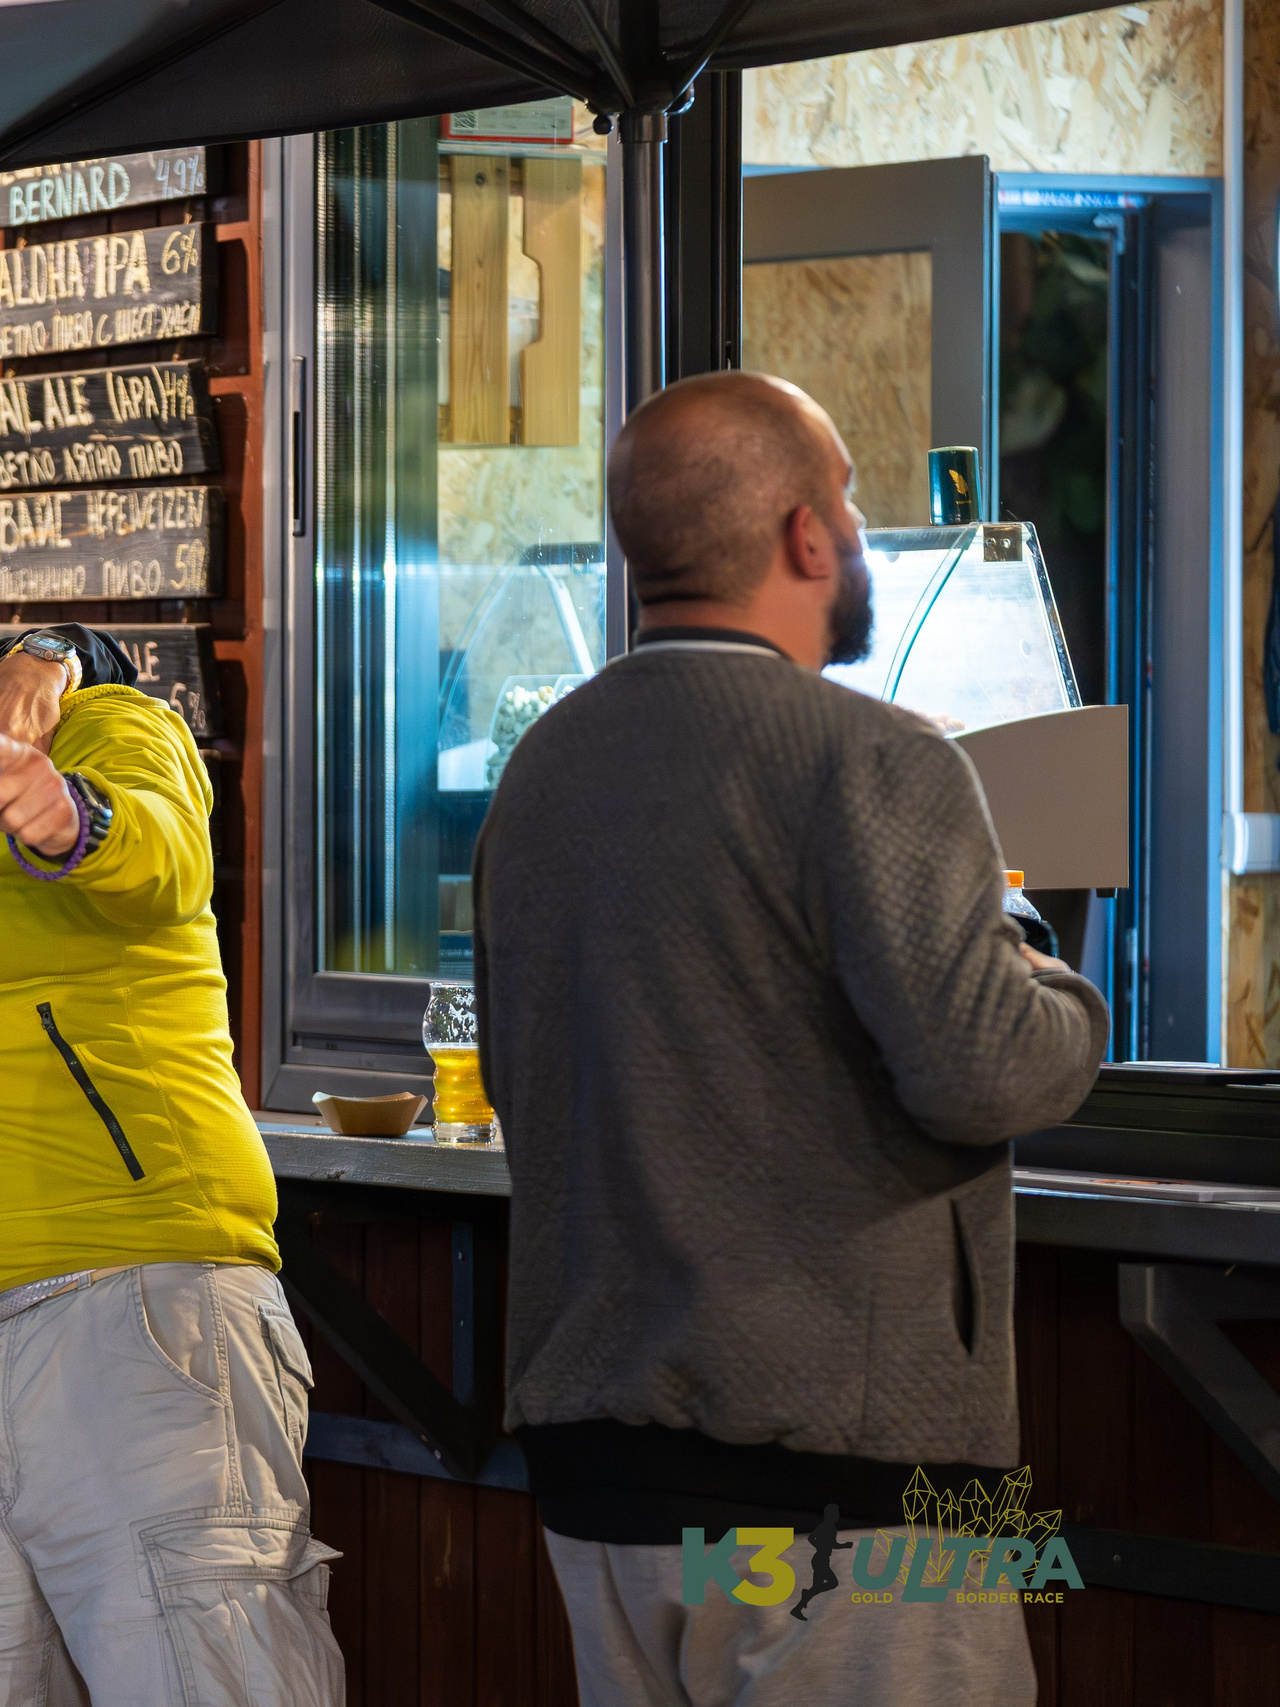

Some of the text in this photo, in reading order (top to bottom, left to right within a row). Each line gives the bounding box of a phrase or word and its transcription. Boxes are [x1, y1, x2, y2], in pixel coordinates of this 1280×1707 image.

[8, 162, 131, 227] BERNARD
[91, 229, 152, 299] IPA
[161, 227, 198, 275] 6%
[51, 310, 93, 352] ПИВО
[43, 376, 95, 432] ALE
[128, 440, 184, 479] ПИВО
[102, 558, 163, 598] ПИВО
